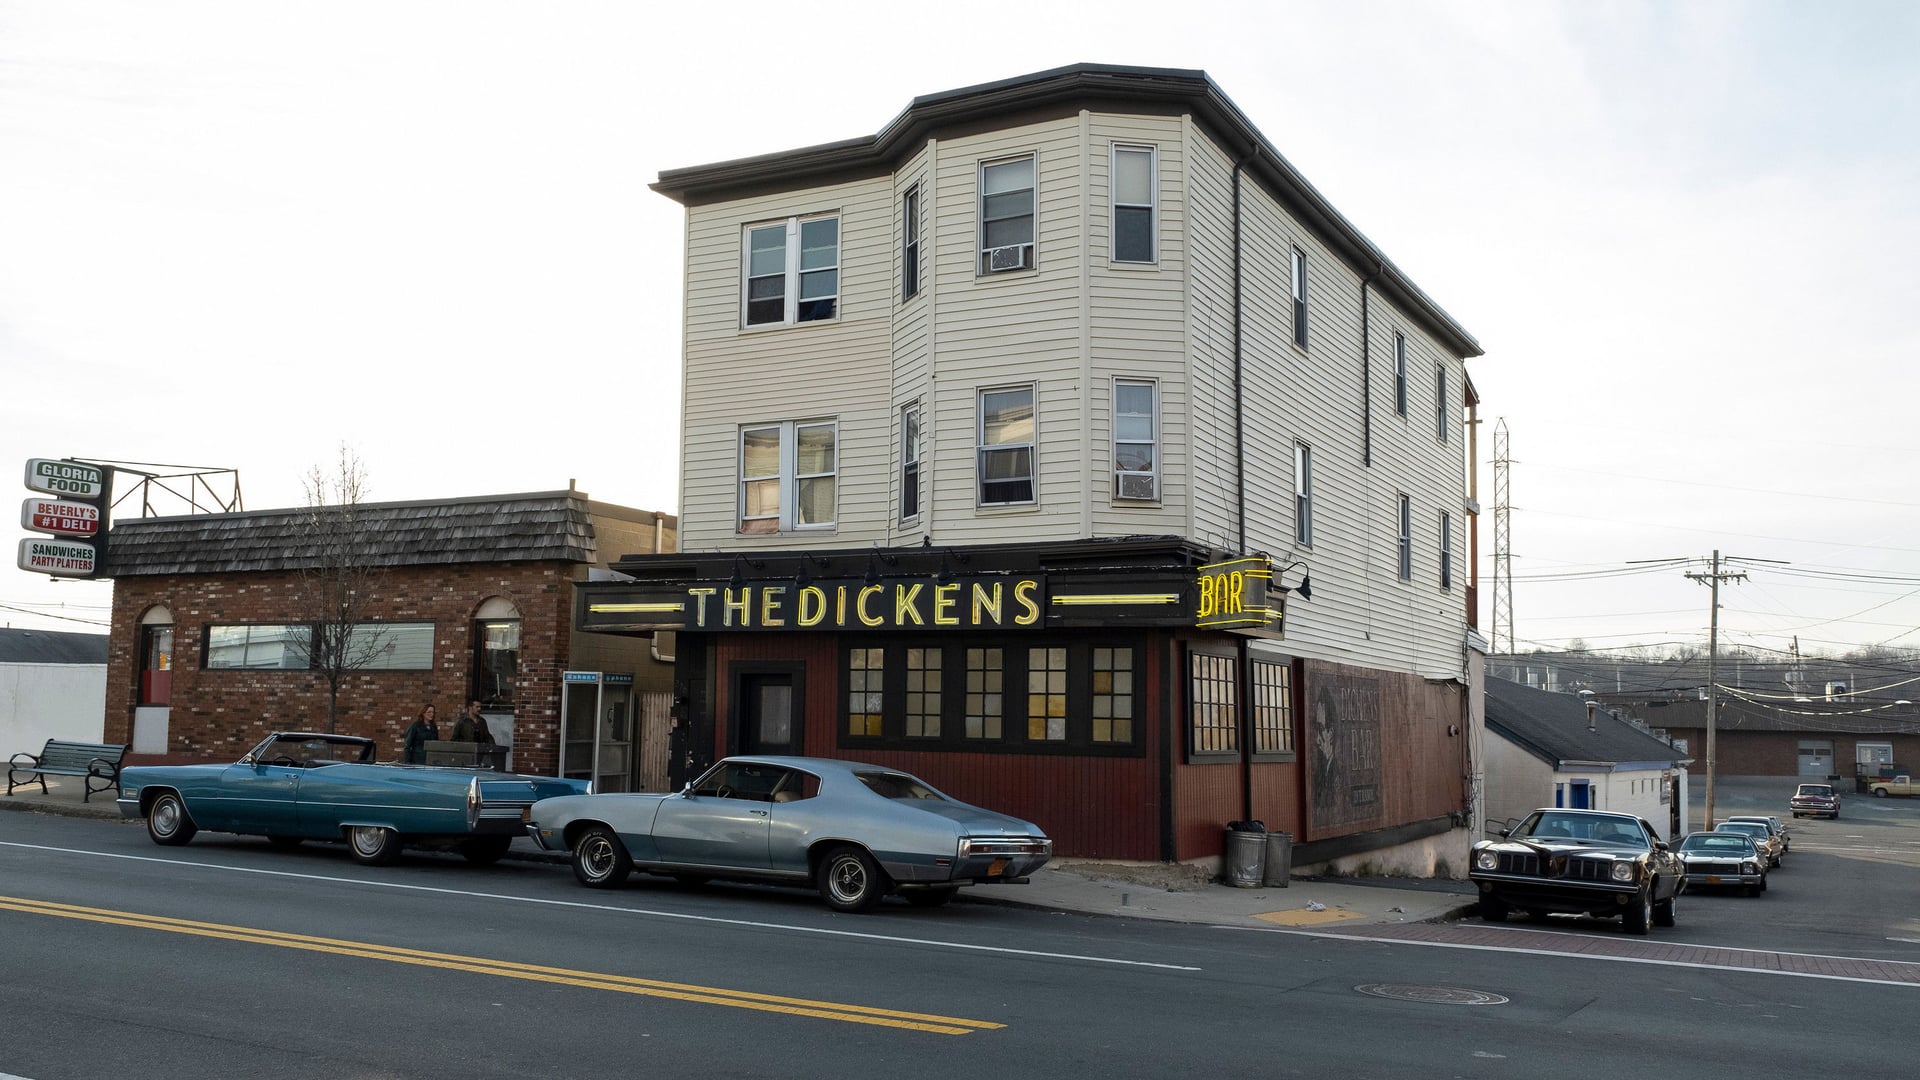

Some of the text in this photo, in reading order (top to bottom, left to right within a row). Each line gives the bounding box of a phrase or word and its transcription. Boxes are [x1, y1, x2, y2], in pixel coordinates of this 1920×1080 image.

[41, 463, 99, 482] GLORIA
[47, 477, 92, 494] FOOD
[38, 503, 97, 519] BEVERLY'S
[41, 516, 91, 531] #1 DELI
[32, 543, 93, 560] SANDWICHES
[31, 555, 93, 571] PARTY PLATTERS
[1200, 570, 1243, 617] BAR
